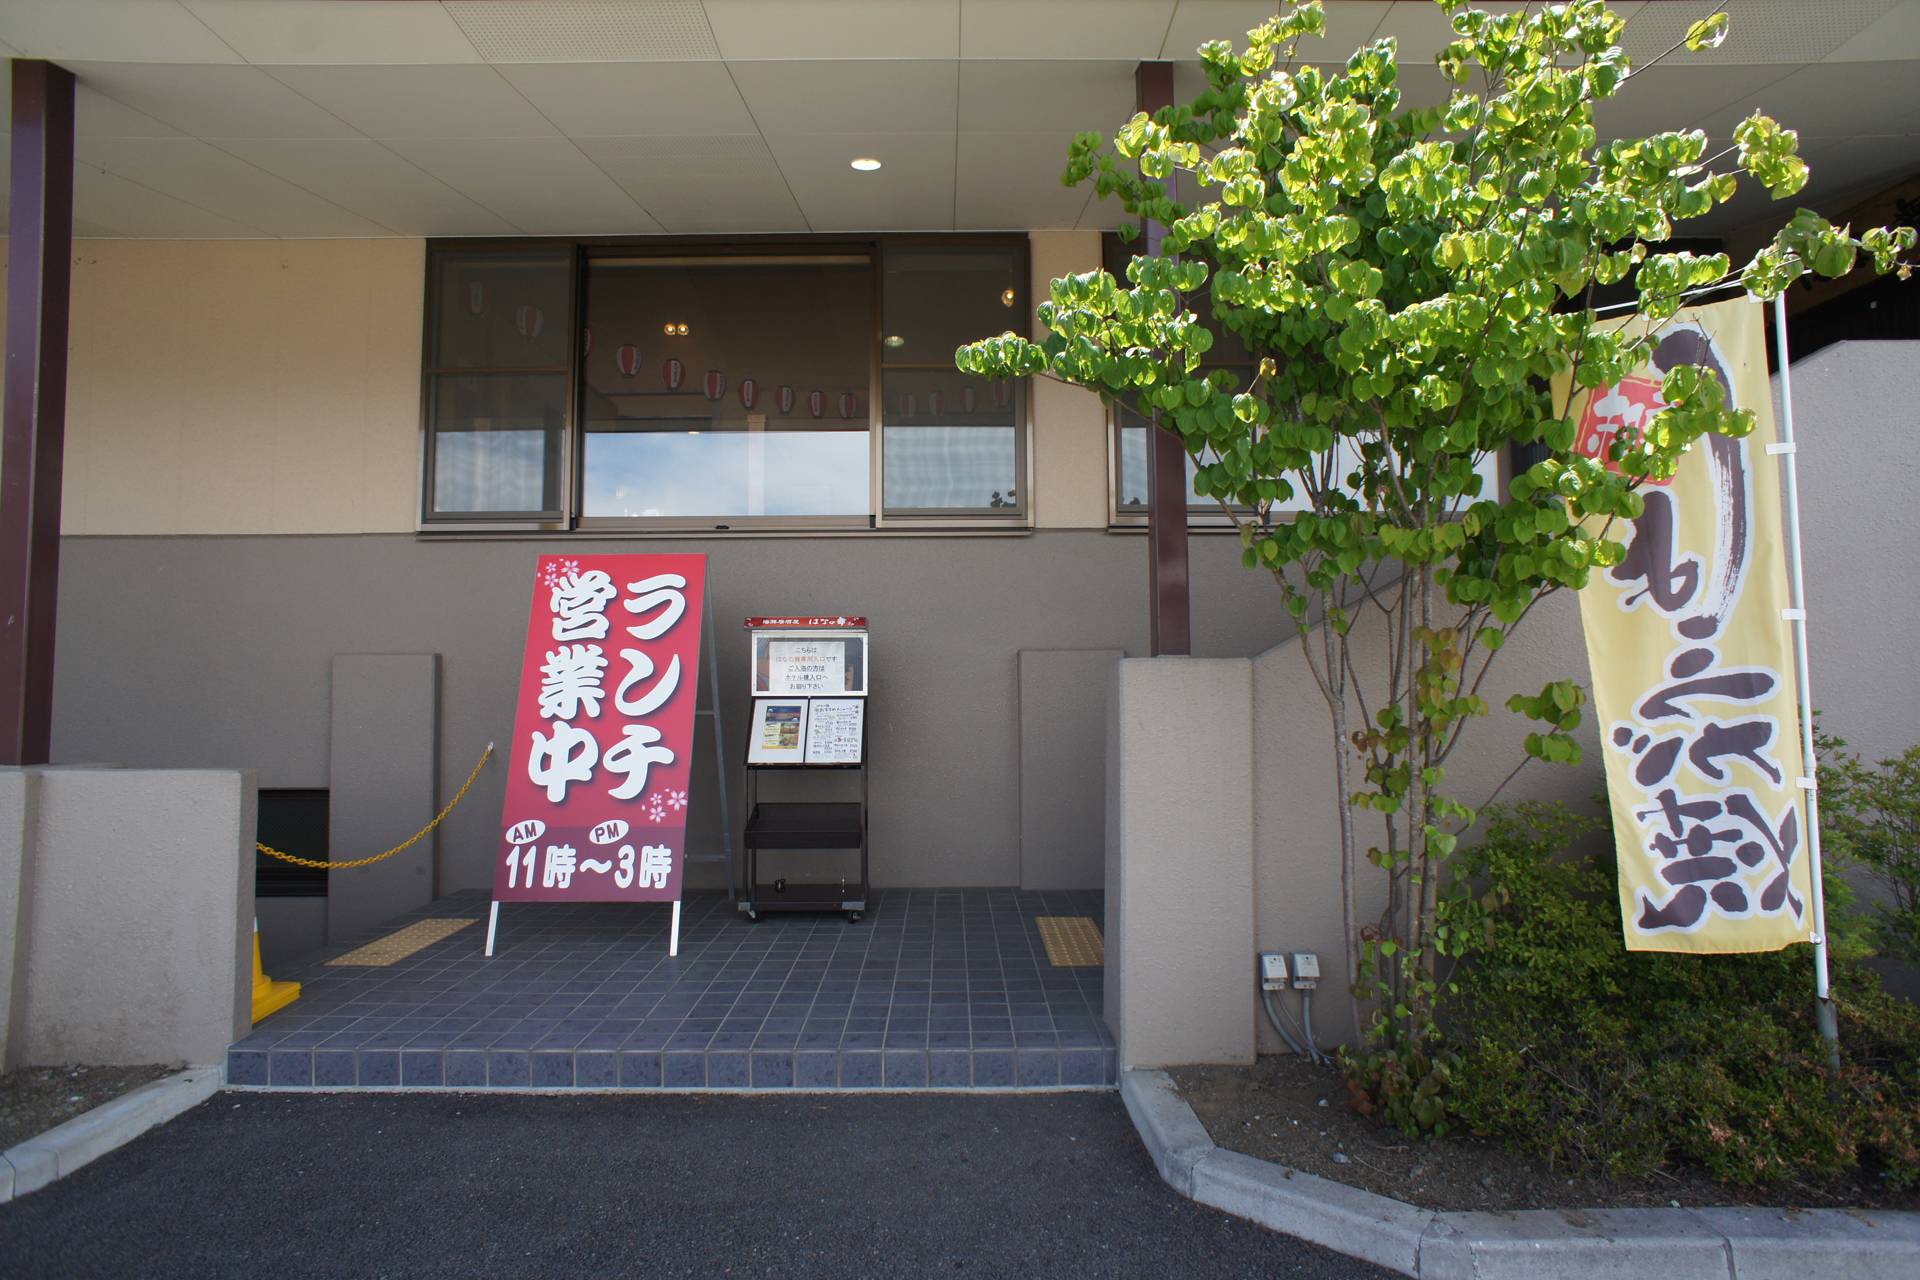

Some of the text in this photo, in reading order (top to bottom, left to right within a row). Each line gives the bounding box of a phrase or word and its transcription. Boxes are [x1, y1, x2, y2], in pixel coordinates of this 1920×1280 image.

[808, 616, 847, 627] はなの舞
[528, 569, 618, 803] 営業中
[603, 573, 687, 800] ランチ
[512, 820, 620, 843] AM PM
